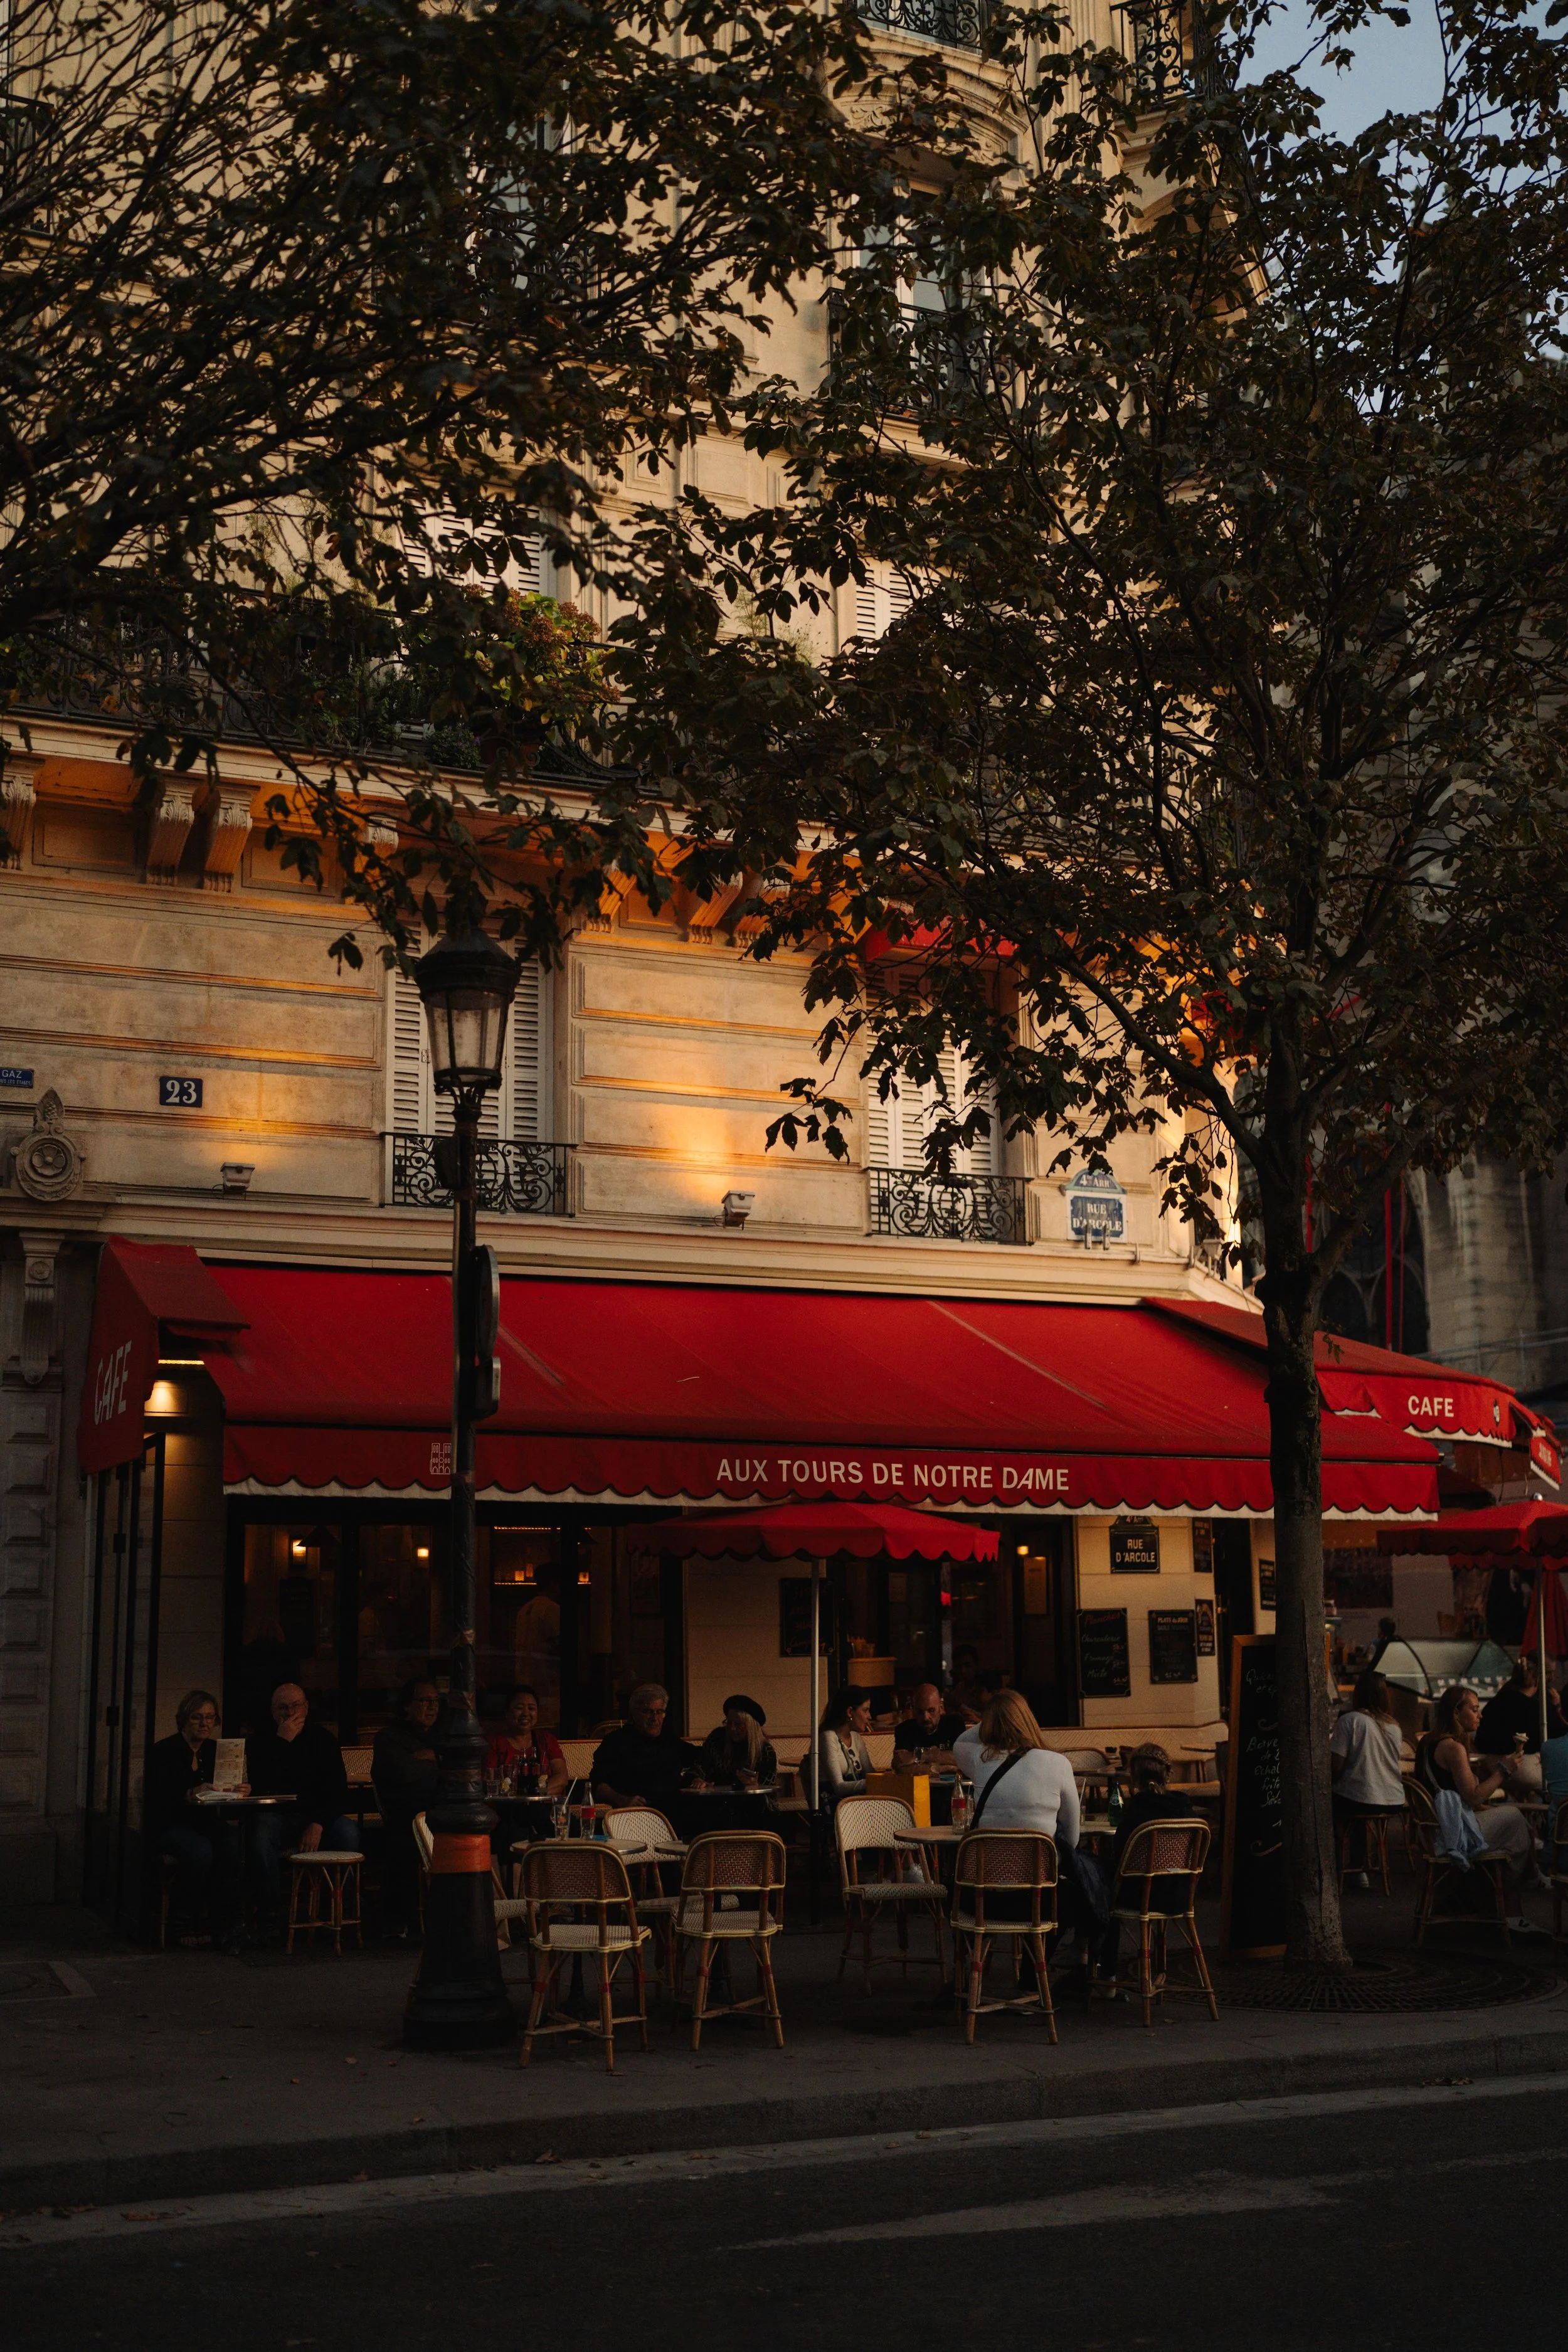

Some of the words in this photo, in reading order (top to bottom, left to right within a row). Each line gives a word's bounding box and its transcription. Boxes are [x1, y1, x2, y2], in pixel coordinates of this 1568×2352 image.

[2, 1069, 23, 1079] GAZ
[166, 1079, 197, 1104] 23
[1087, 1202, 1107, 1215] RUE
[1072, 1217, 1123, 1232] D'ARCOLE
[94, 1339, 132, 1426] CAFE
[1407, 1395, 1454, 1417] CAFE
[716, 1458, 768, 1482] AUX
[778, 1459, 864, 1483] TOURS
[872, 1462, 904, 1485] DE
[914, 1464, 993, 1488] NOTRE
[1002, 1467, 1069, 1491] DAME
[1127, 1539, 1143, 1549] RUE
[1116, 1552, 1155, 1562] D'ARCOLE
[1246, 1736, 1278, 1752] Bave
[1254, 1762, 1280, 1776] Echal
